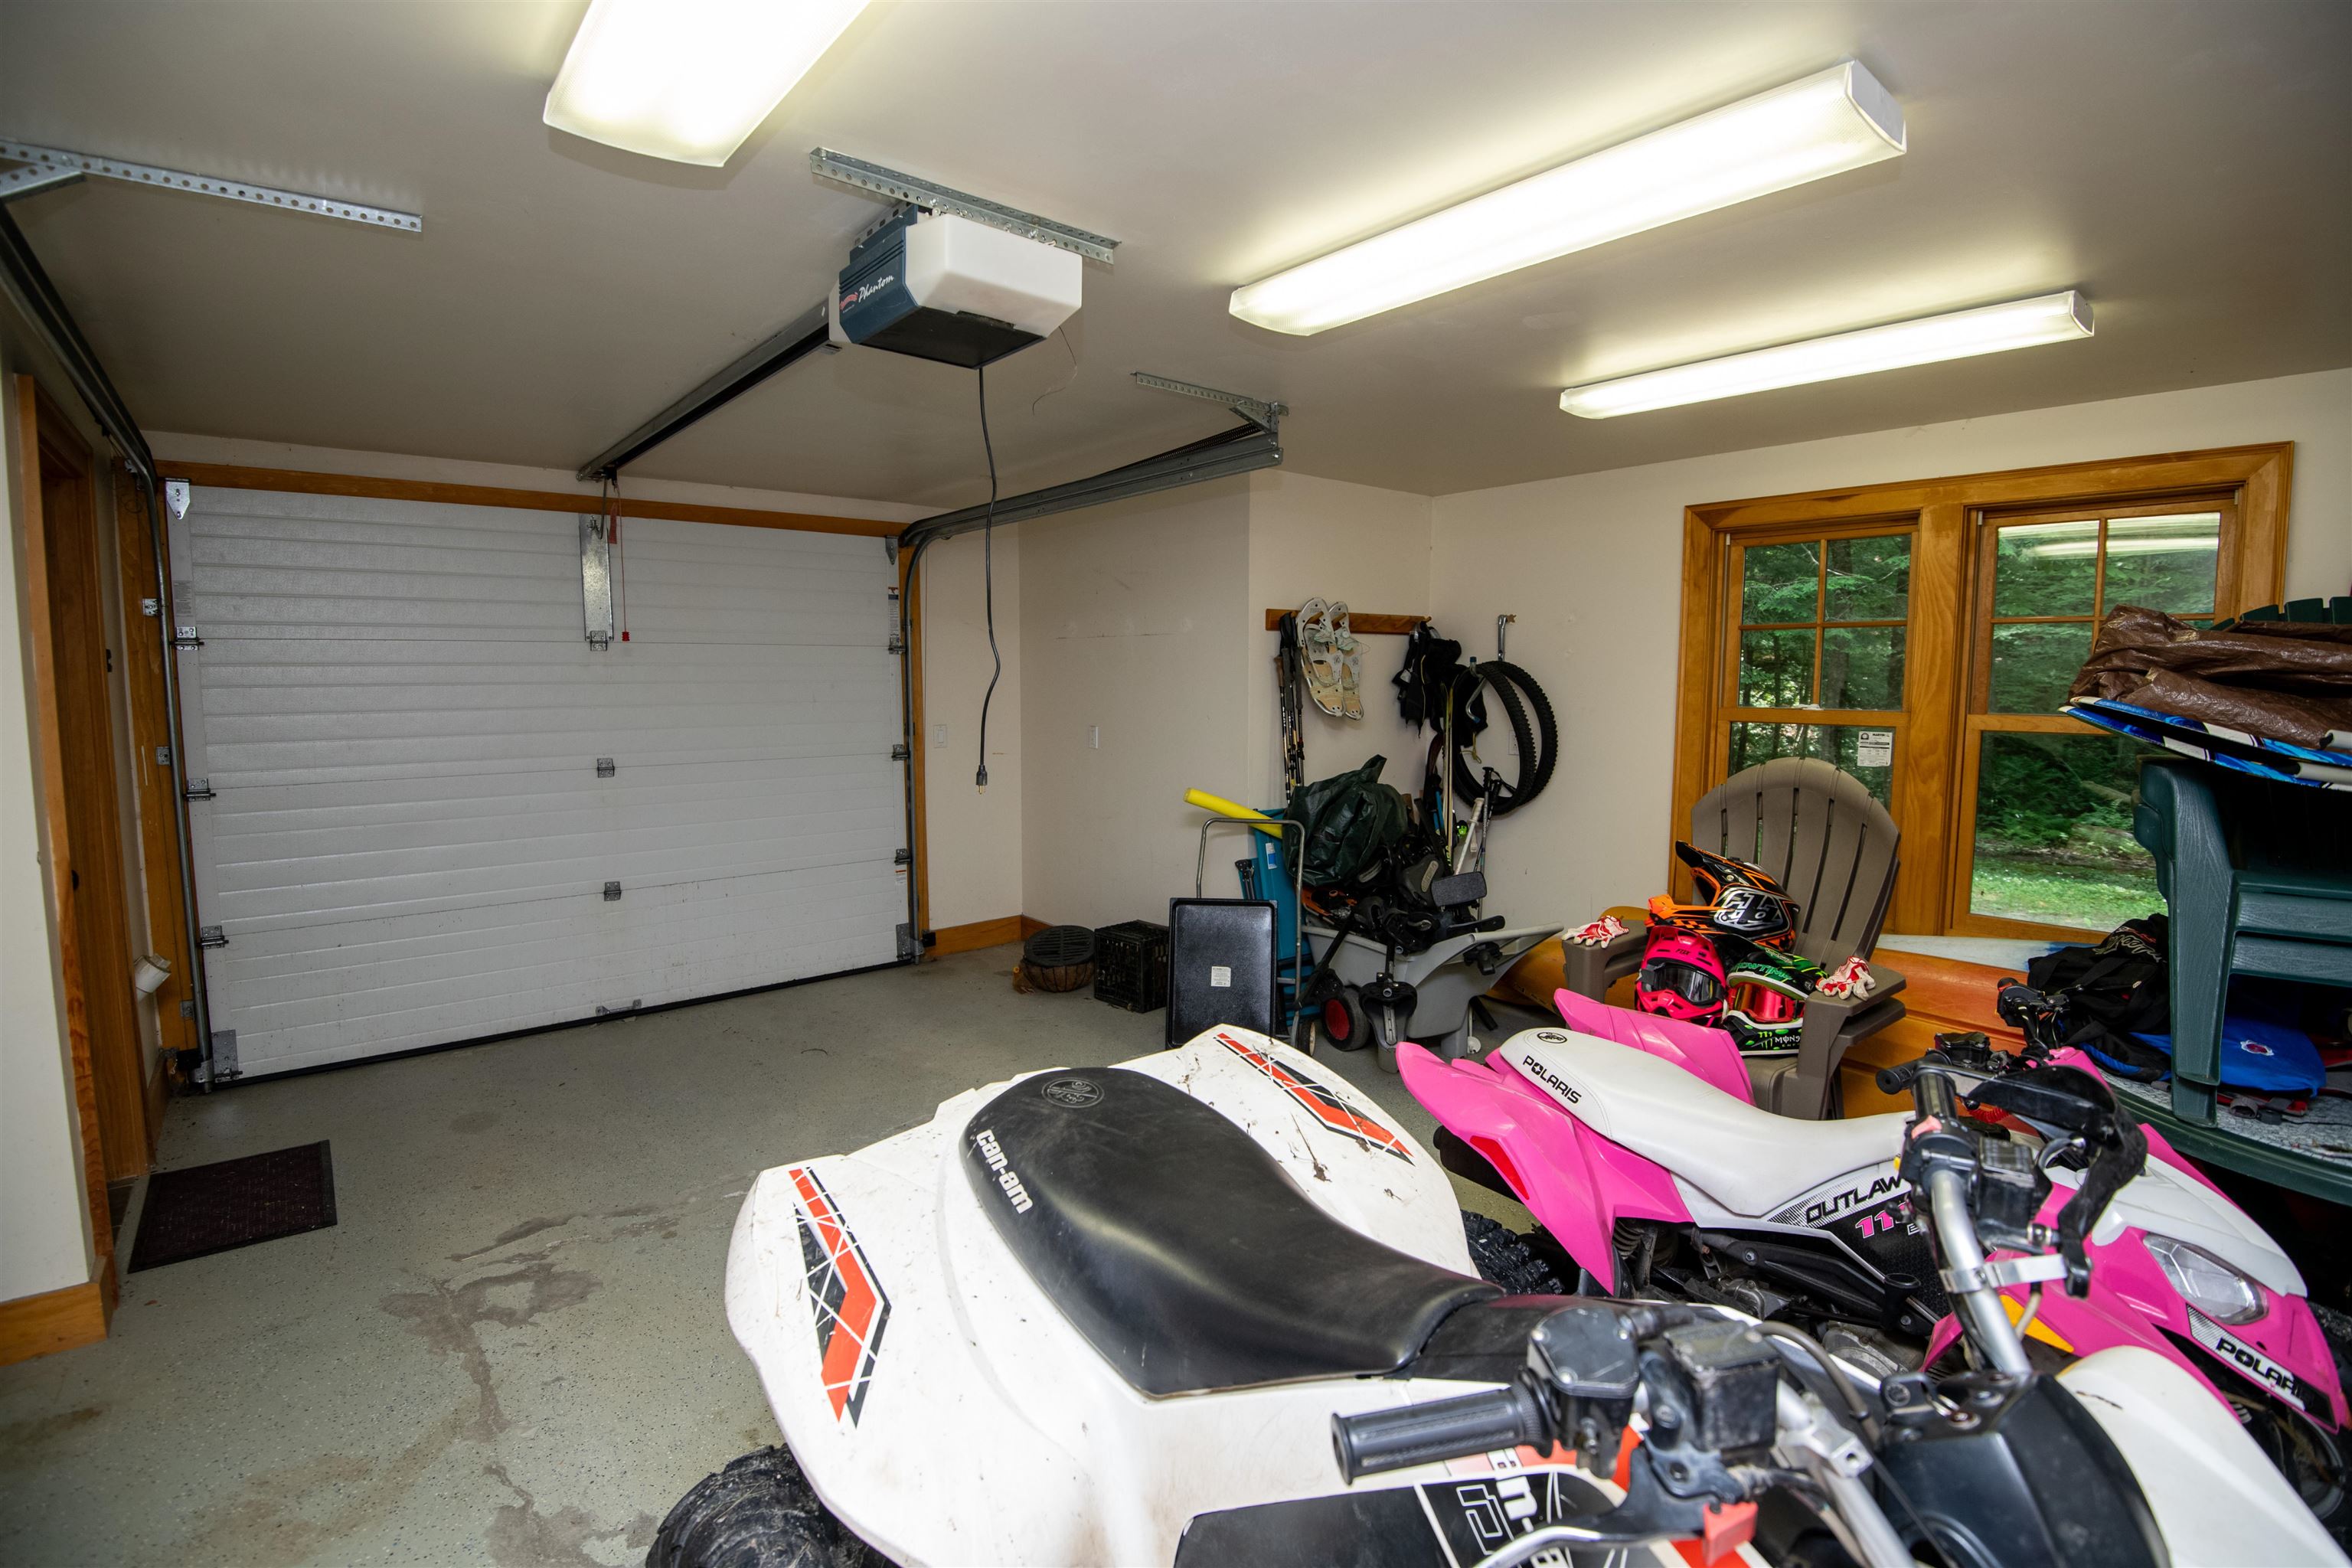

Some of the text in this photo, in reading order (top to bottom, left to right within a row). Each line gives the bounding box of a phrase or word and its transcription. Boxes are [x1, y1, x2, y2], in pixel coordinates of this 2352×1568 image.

[858, 275, 895, 303] Phantom
[1522, 1054, 1583, 1104] POLARIS
[976, 1129, 1034, 1214] can-am
[1805, 1175, 1903, 1224] OUTLAW
[2216, 1336, 2301, 1396] POLAR
